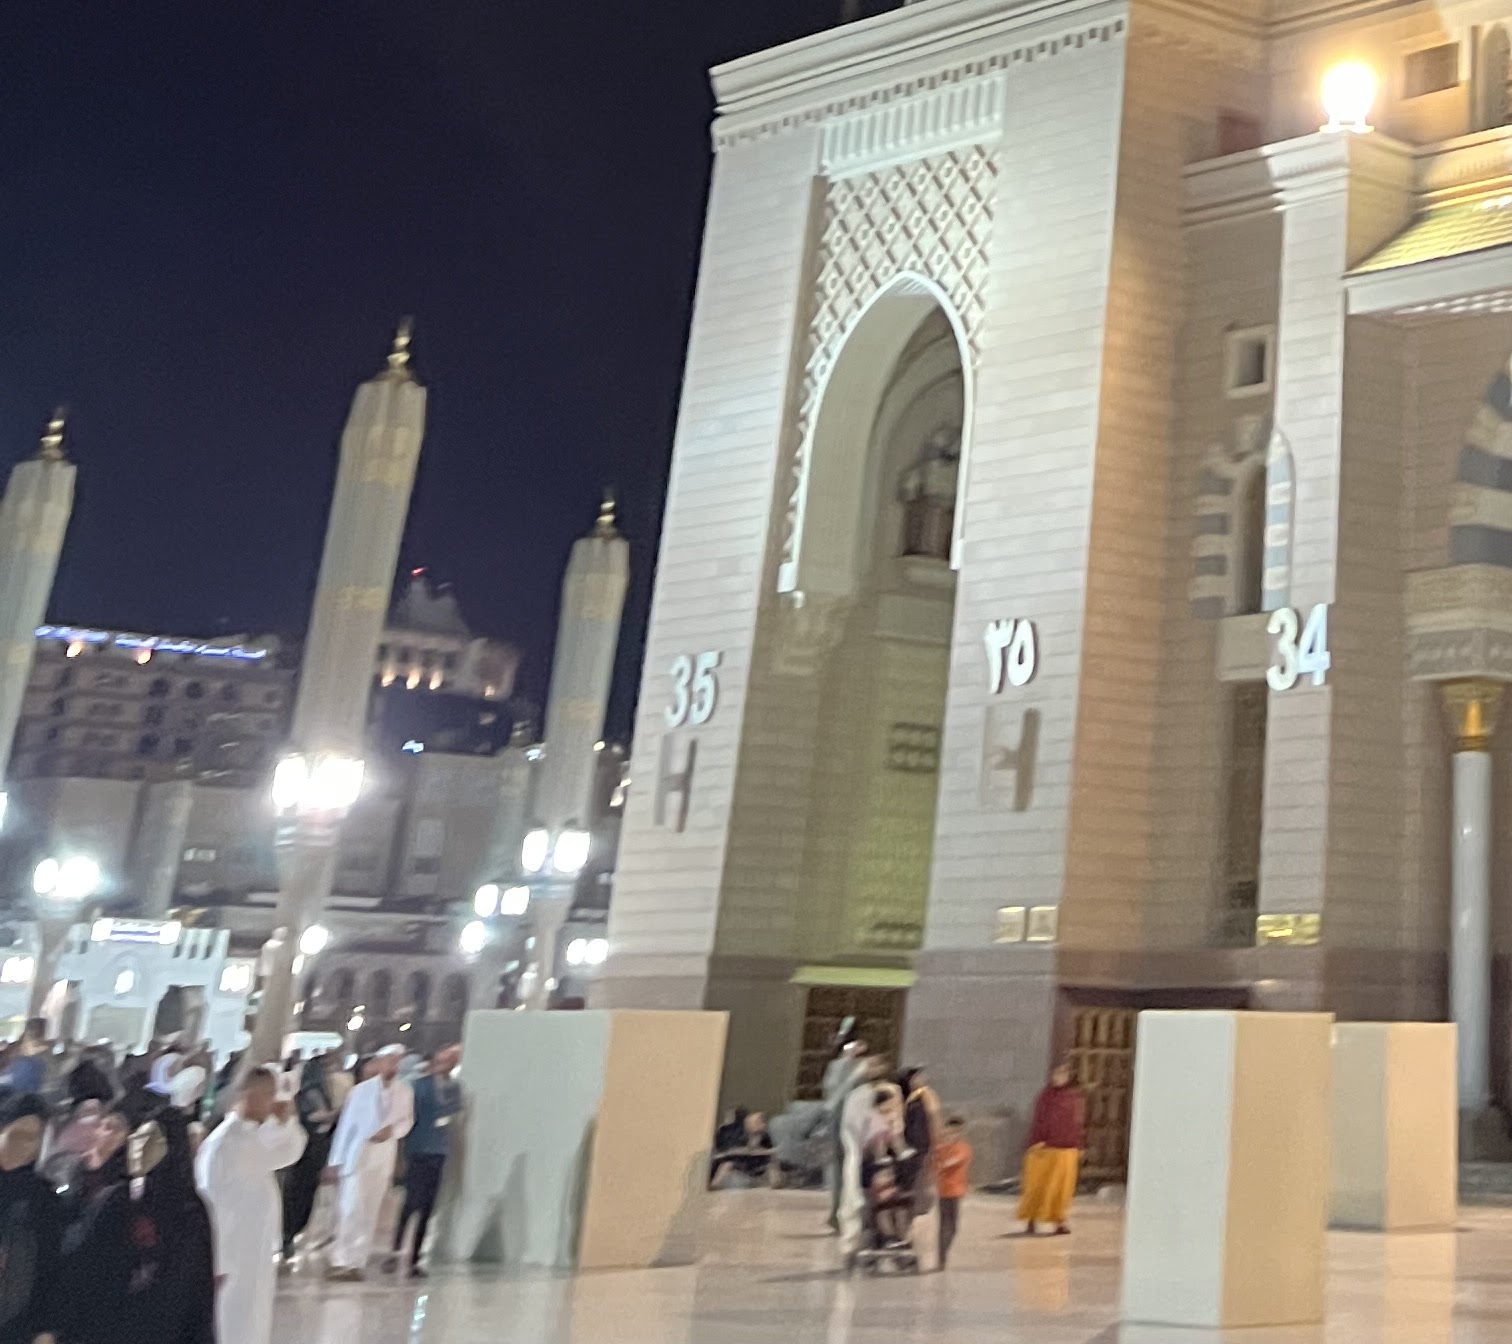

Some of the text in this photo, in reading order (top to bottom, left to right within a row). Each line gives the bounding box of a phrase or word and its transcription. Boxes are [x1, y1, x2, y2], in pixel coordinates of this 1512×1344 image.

[666, 650, 722, 728] 35
[984, 618, 1039, 695] ٣٥
[1266, 603, 1331, 691] 34
[654, 733, 698, 833] H
[979, 705, 1041, 812] H
